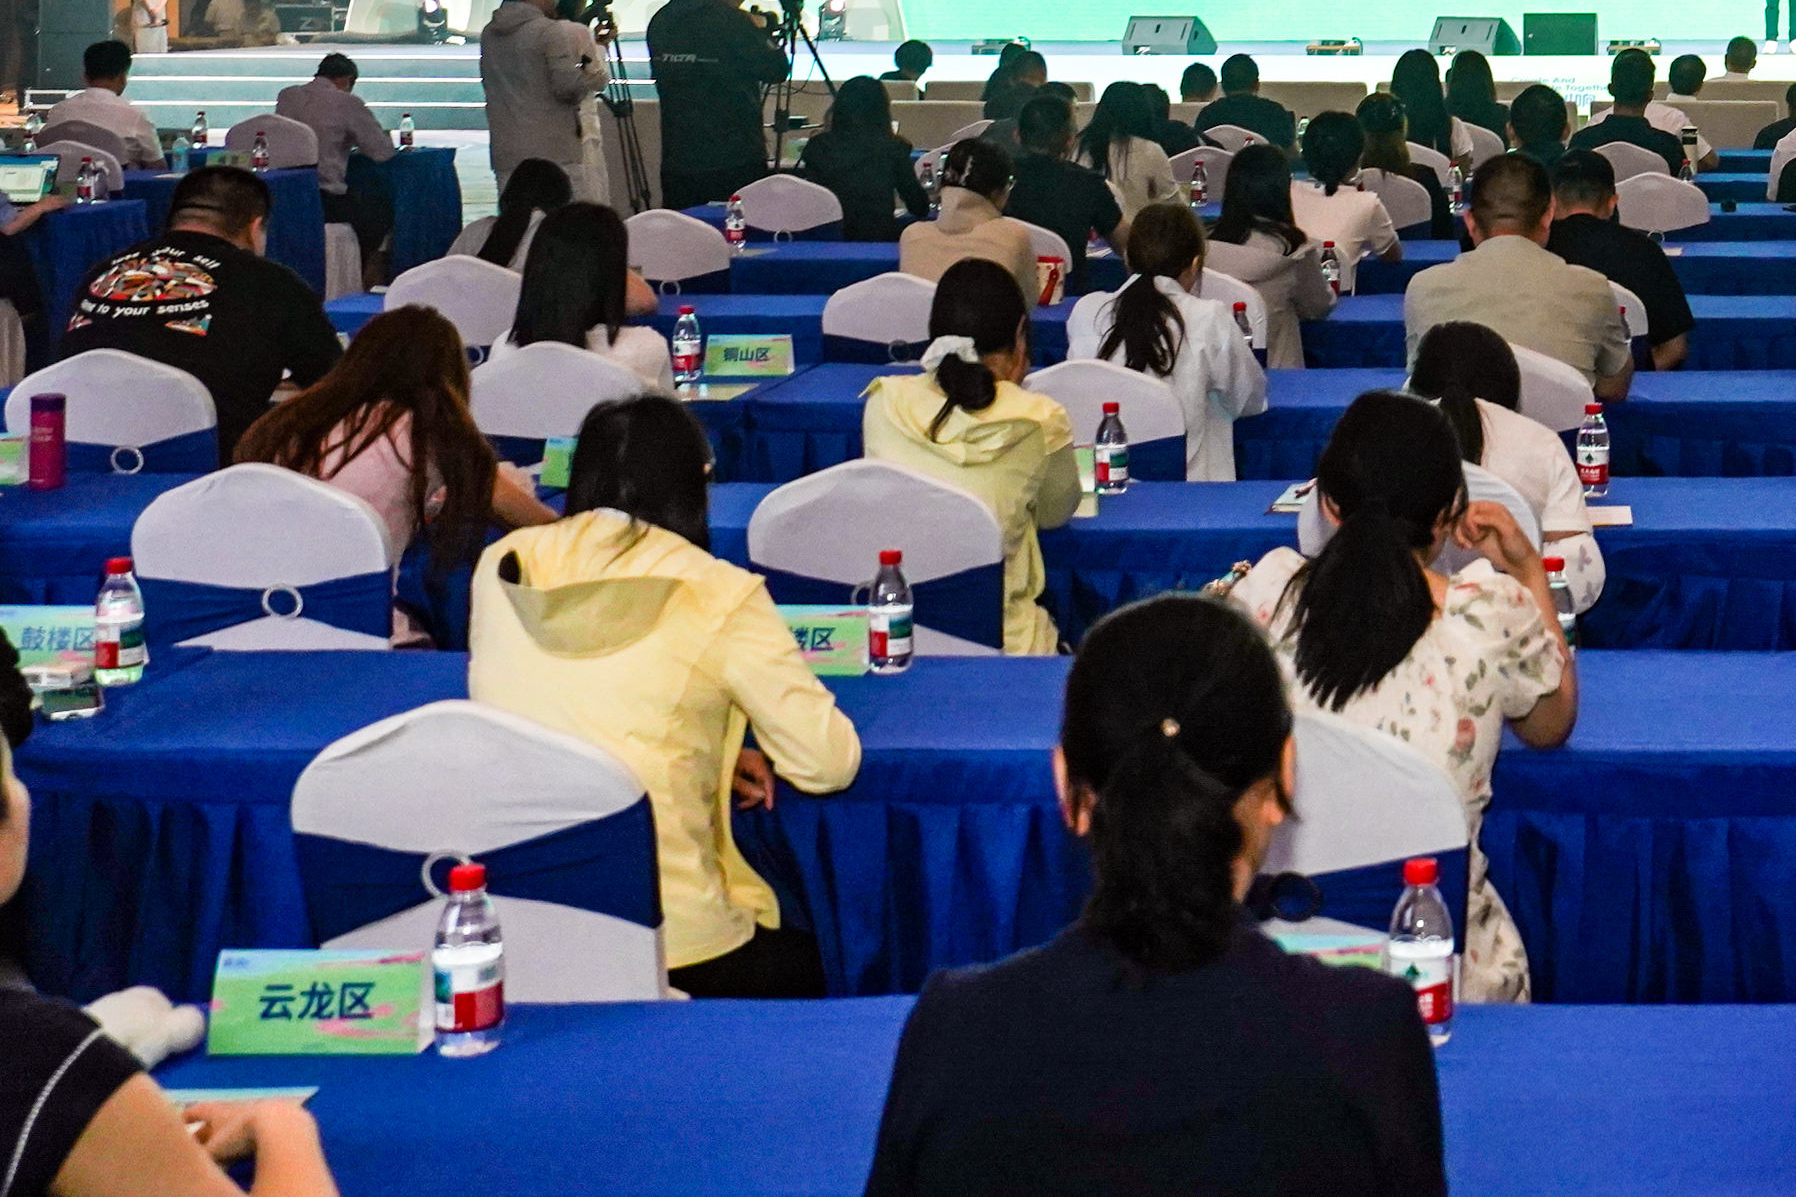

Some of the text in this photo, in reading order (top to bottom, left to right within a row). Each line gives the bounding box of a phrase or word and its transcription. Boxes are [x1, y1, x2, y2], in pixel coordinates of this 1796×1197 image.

[112, 306, 150, 318] your
[156, 299, 209, 315] senses
[259, 981, 376, 1021] 云龙区
